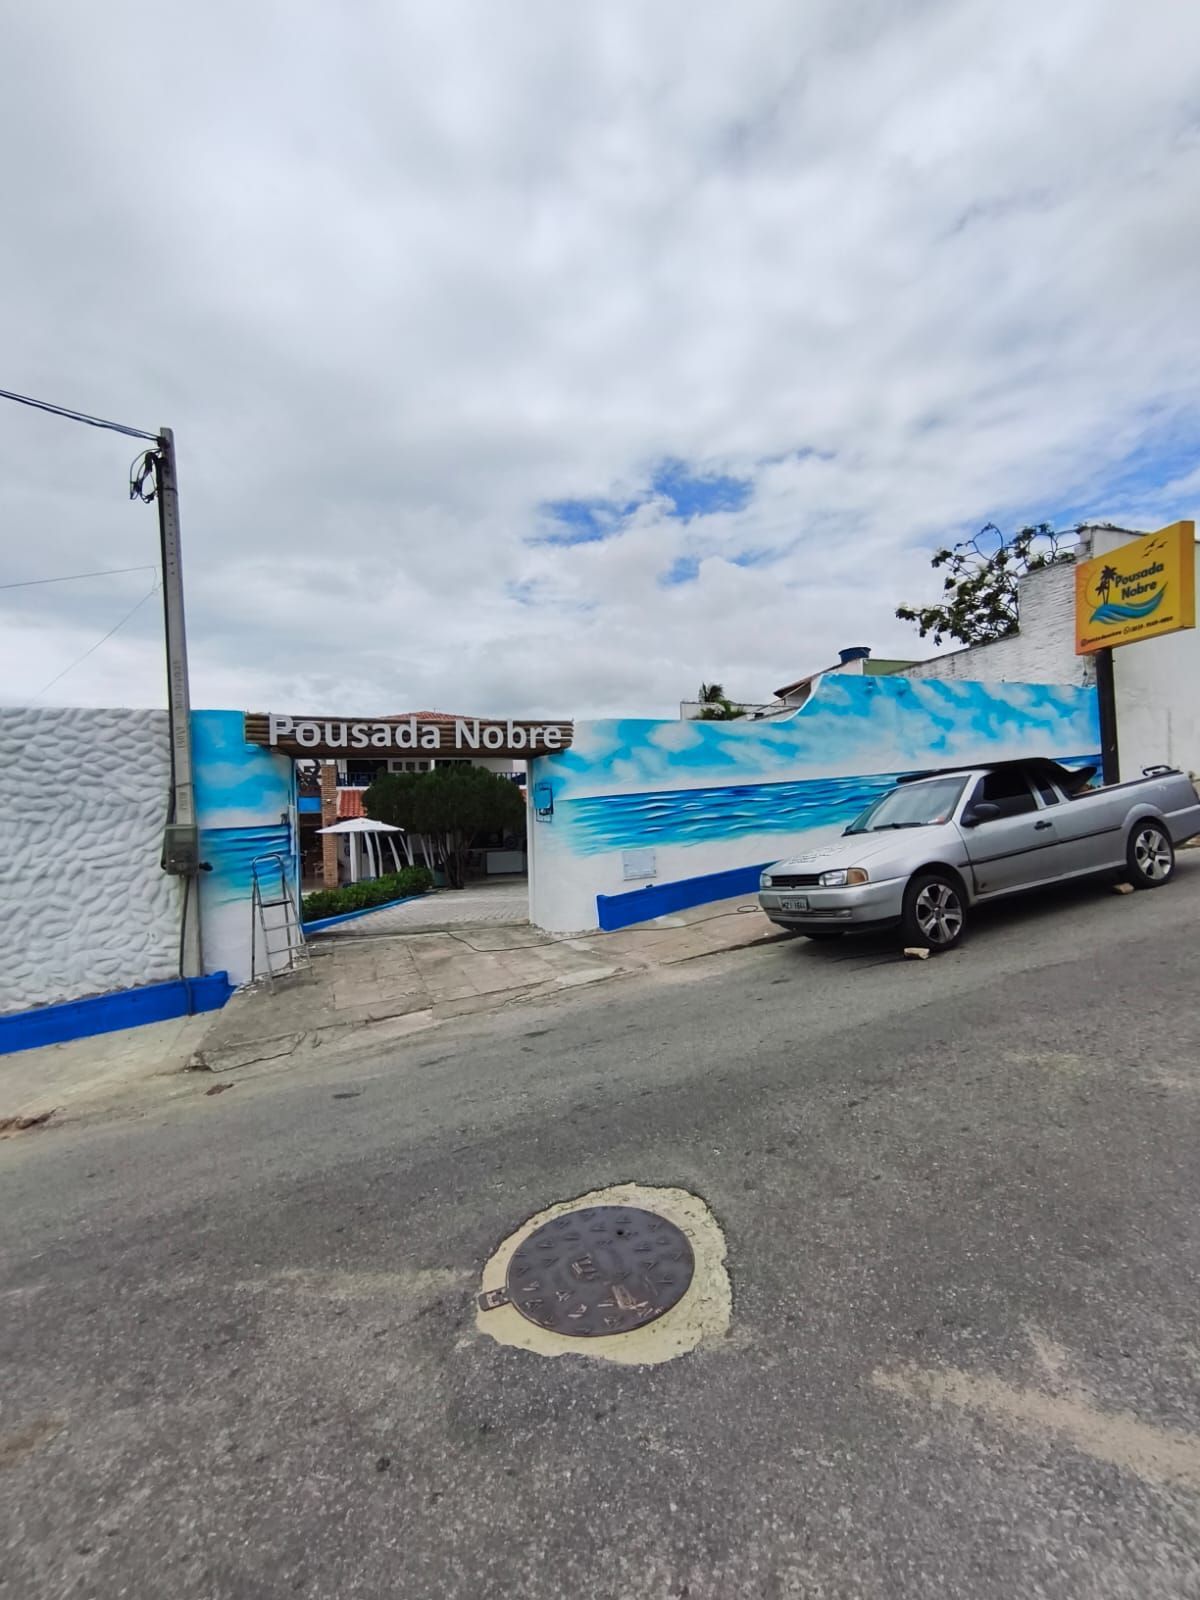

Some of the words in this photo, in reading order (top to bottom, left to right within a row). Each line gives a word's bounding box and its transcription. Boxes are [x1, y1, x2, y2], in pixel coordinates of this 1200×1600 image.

[1115, 561, 1164, 588] Pousada
[1121, 581, 1157, 600] Nobre
[268, 714, 441, 749] Pousada
[455, 718, 562, 749] Nobre
